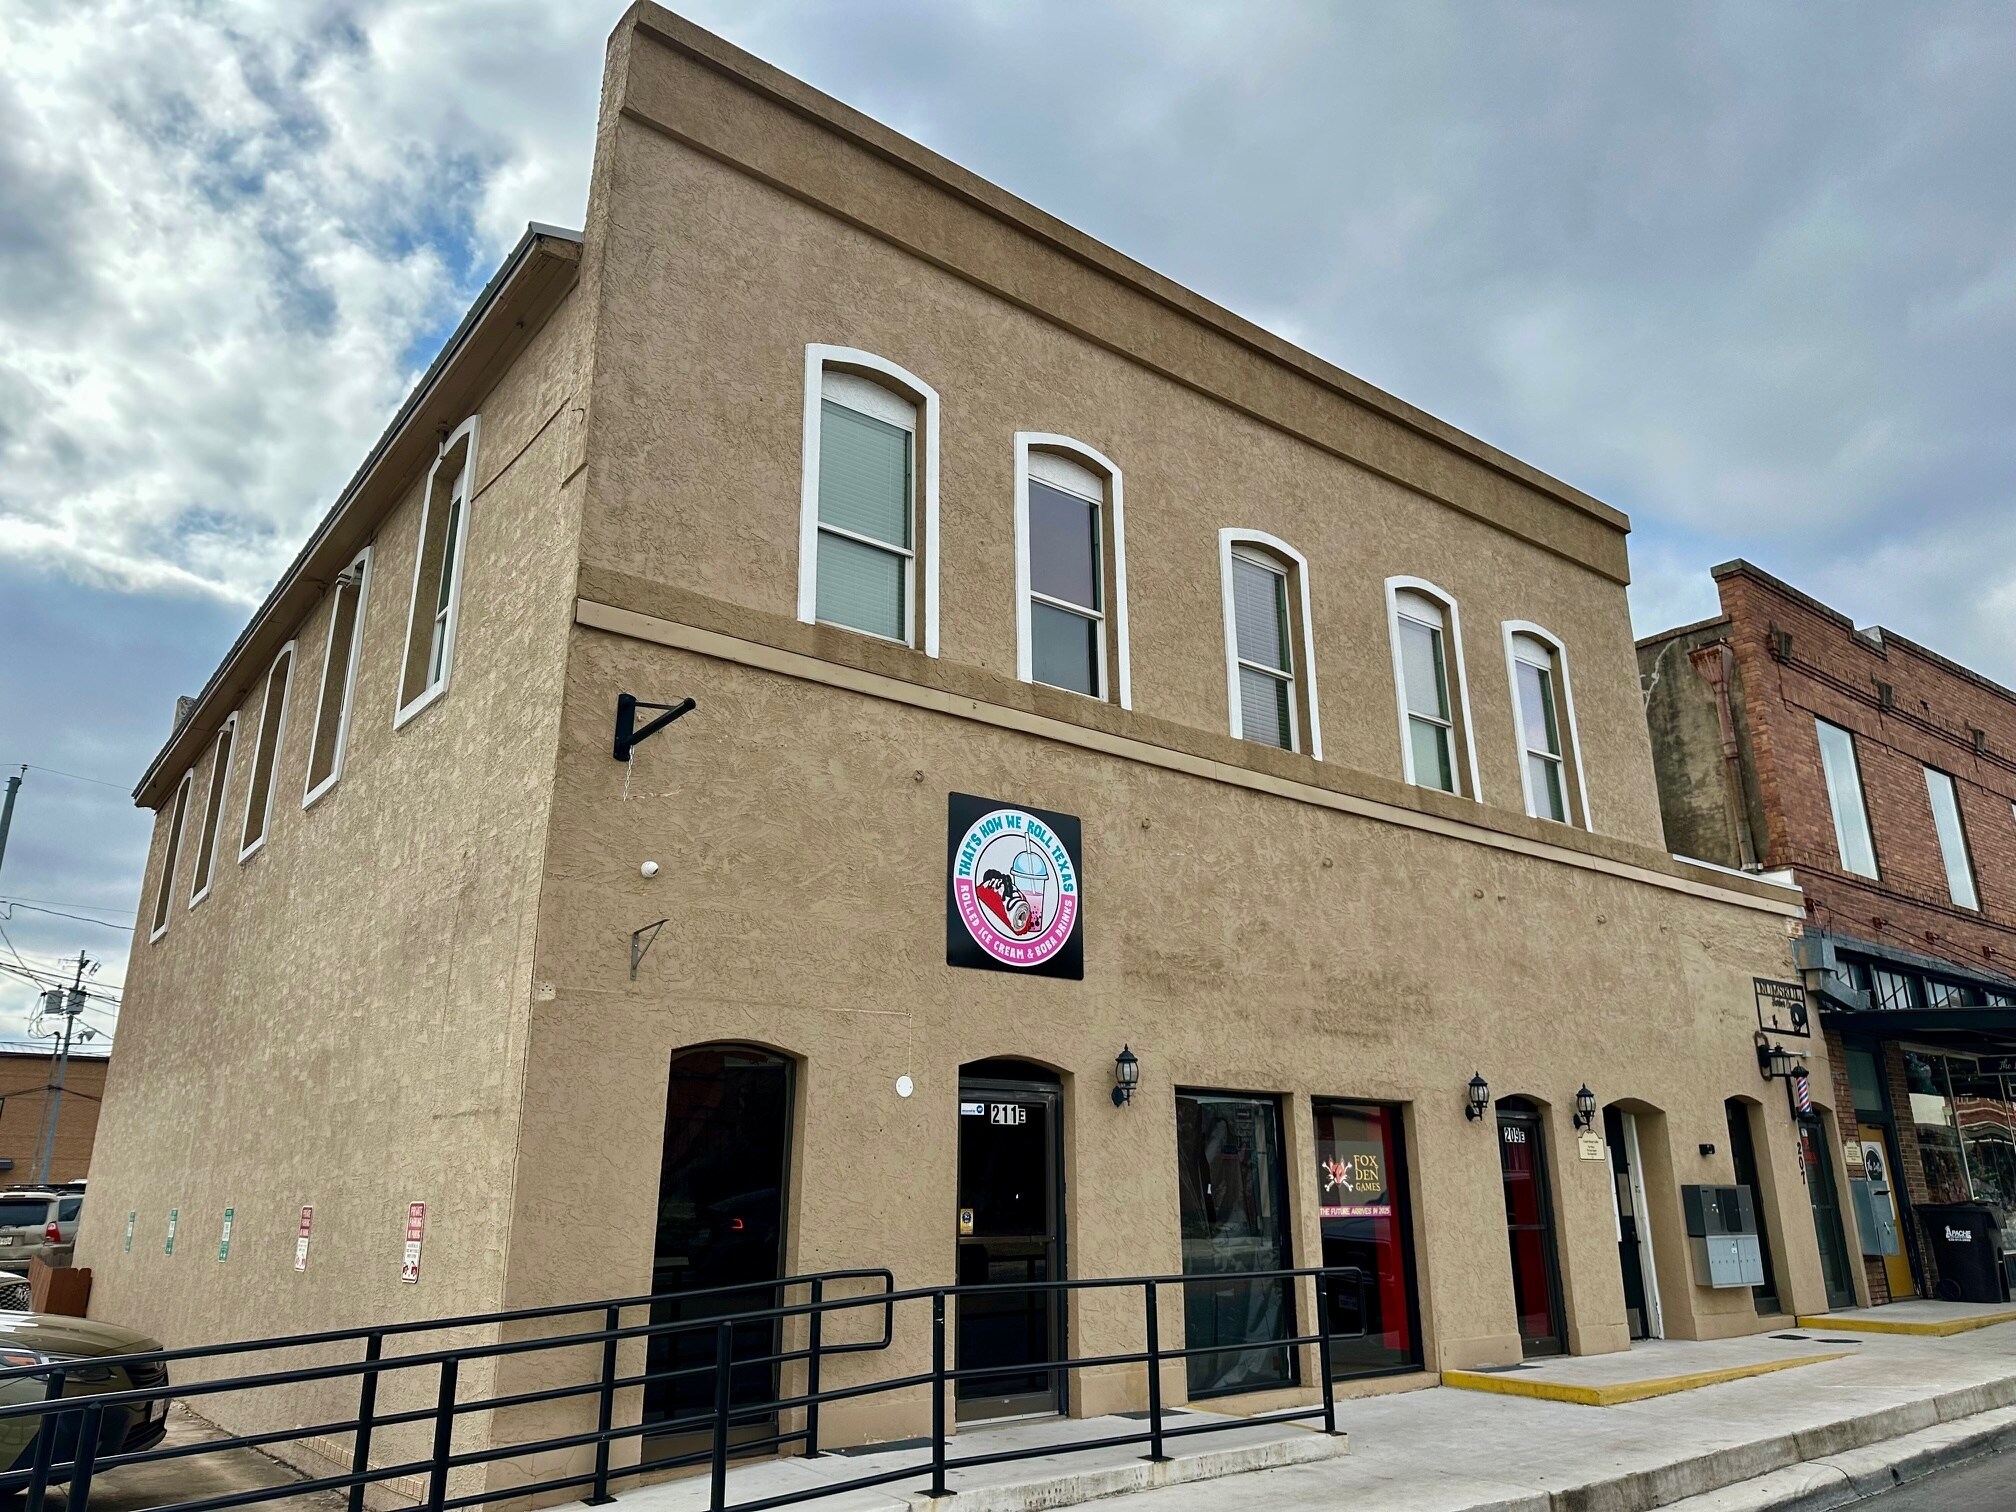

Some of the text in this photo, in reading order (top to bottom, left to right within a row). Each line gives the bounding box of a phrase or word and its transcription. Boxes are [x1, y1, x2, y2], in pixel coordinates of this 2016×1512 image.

[958, 815, 1074, 893] THAT'S HOW WE ROLL TEXAS
[960, 884, 1073, 960] ROLLED ICE CREAM & BOBA DRINKS
[1353, 1154, 1378, 1170] FOX
[1355, 1168, 1379, 1181] DEN
[1355, 1182, 1381, 1192] GAMES
[1320, 1207, 1330, 1216] THE
[1331, 1207, 1351, 1216] FUTURE
[1351, 1207, 1372, 1215] ARRIVES
[1372, 1206, 1378, 1215] IN
[1945, 1226, 1971, 1238] APACHE
